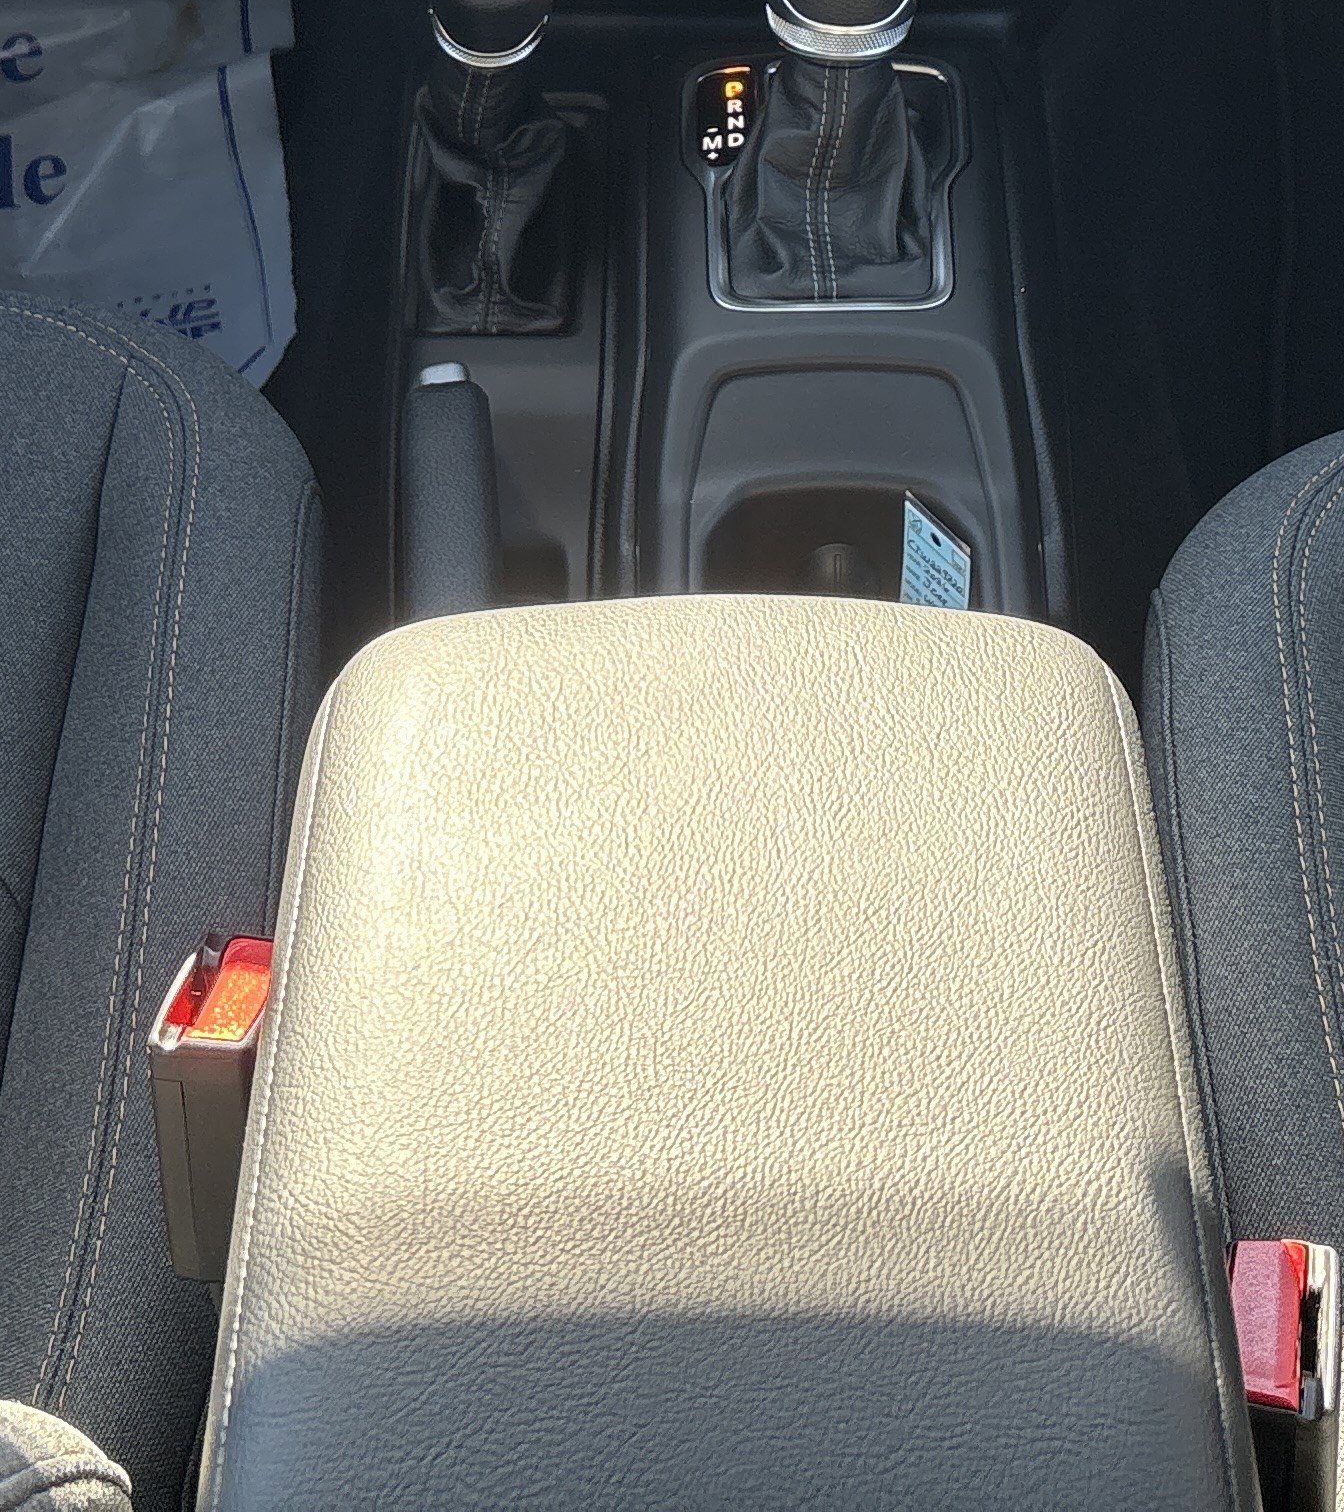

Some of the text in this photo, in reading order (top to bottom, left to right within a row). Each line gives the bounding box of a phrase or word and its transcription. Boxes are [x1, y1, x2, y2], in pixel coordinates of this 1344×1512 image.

[725, 81, 743, 98] P
[726, 99, 743, 114] R
[727, 114, 745, 130] N
[702, 134, 723, 151] M
[727, 132, 745, 148] D
